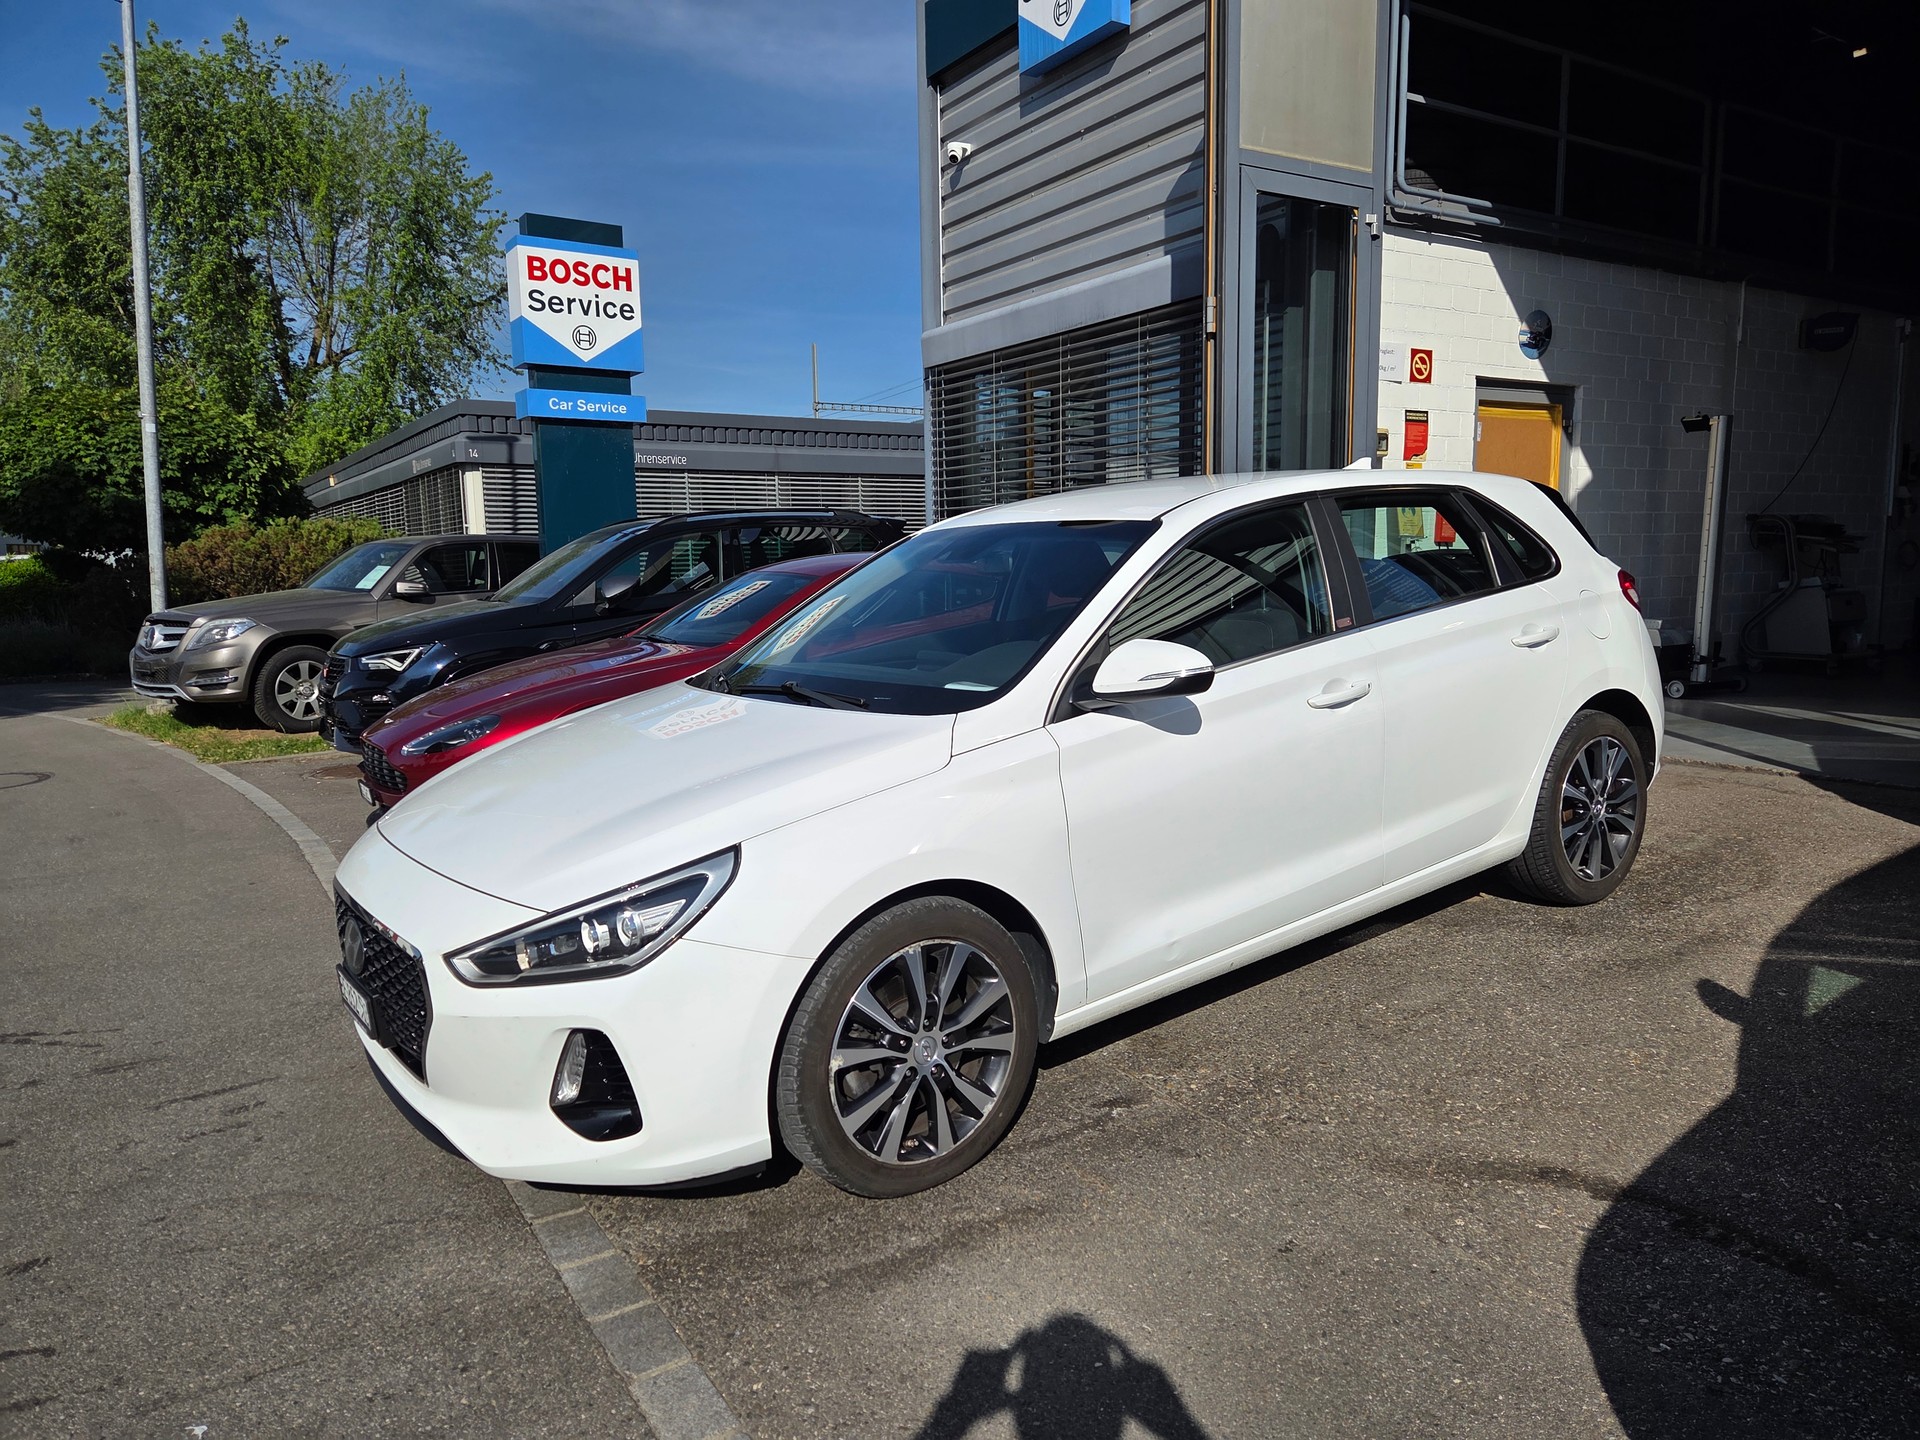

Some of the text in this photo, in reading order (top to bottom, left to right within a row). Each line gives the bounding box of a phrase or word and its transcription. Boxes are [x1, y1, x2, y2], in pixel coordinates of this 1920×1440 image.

[526, 255, 633, 292] BOSCH
[527, 289, 636, 321] Service
[548, 397, 627, 414] Car Service
[468, 448, 479, 458] 14
